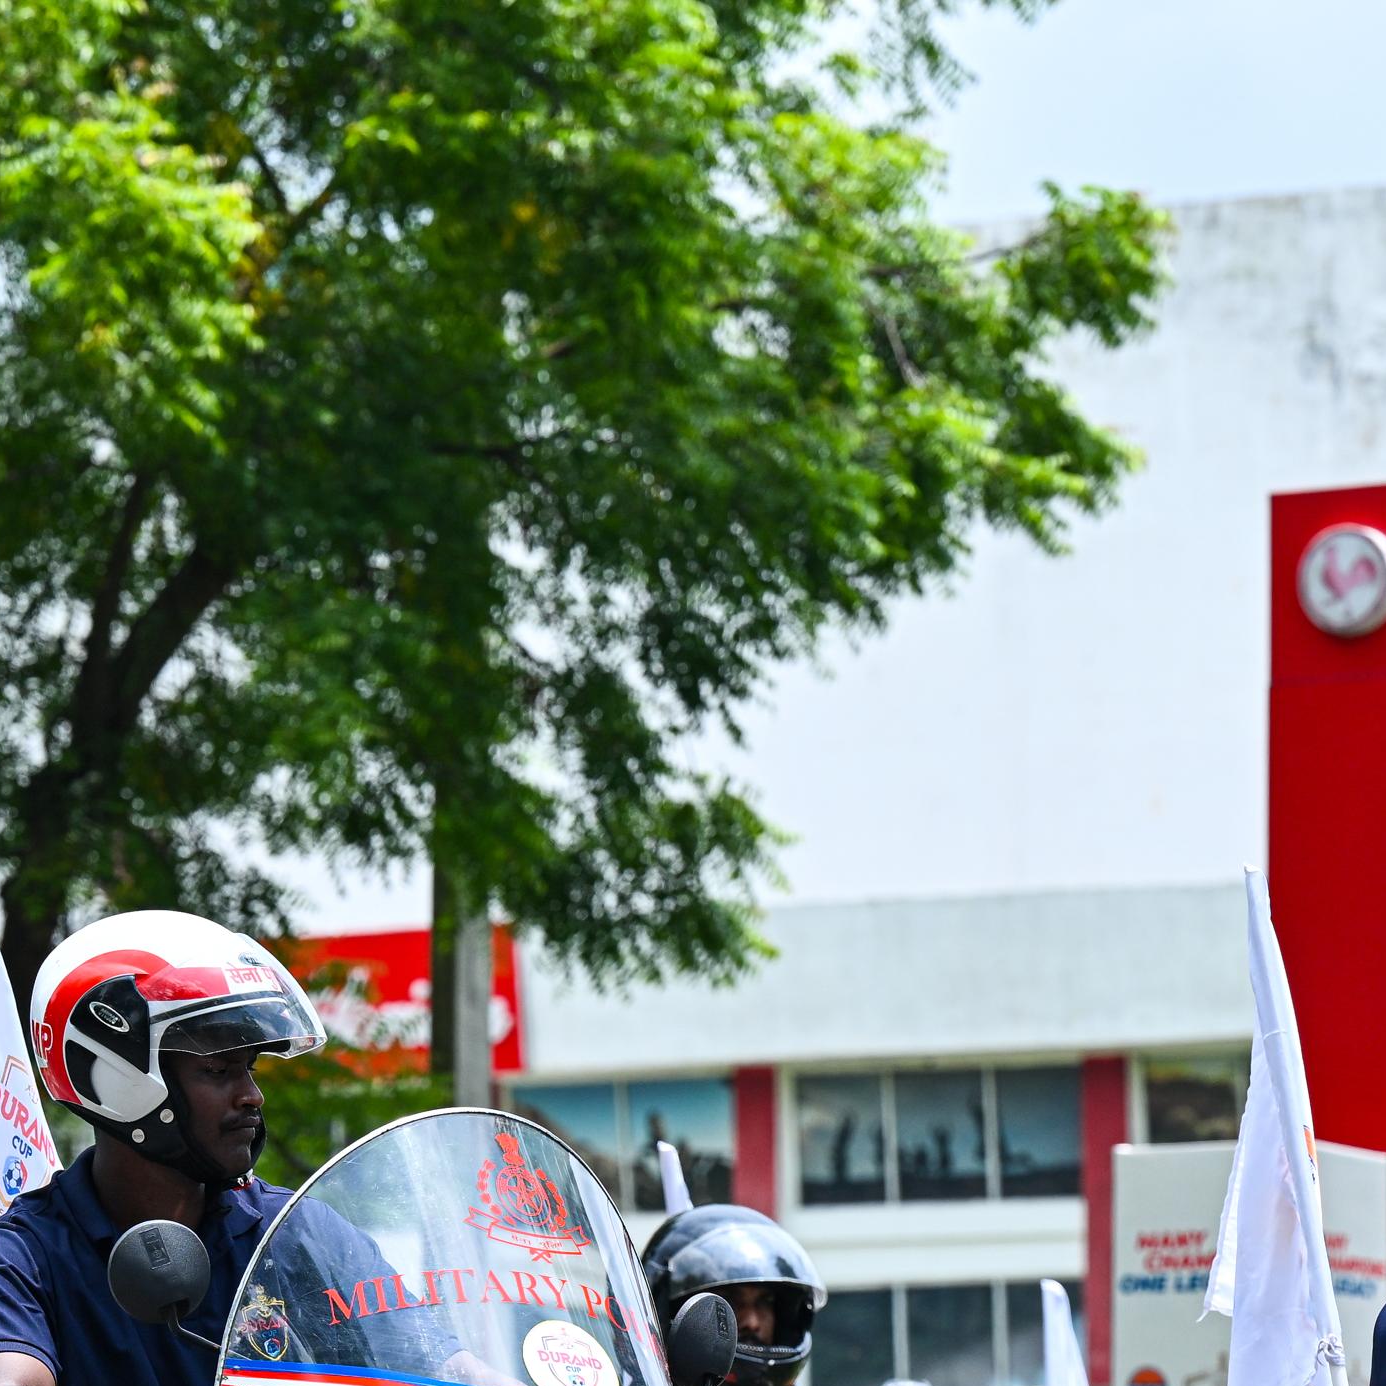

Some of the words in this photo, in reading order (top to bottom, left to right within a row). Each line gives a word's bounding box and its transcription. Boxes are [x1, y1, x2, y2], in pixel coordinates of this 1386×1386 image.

[12, 1135, 33, 1159] CUP
[322, 1268, 570, 1326] MILITARY
[537, 1349, 603, 1371] DURAND
[565, 1365, 582, 1374] CUP
